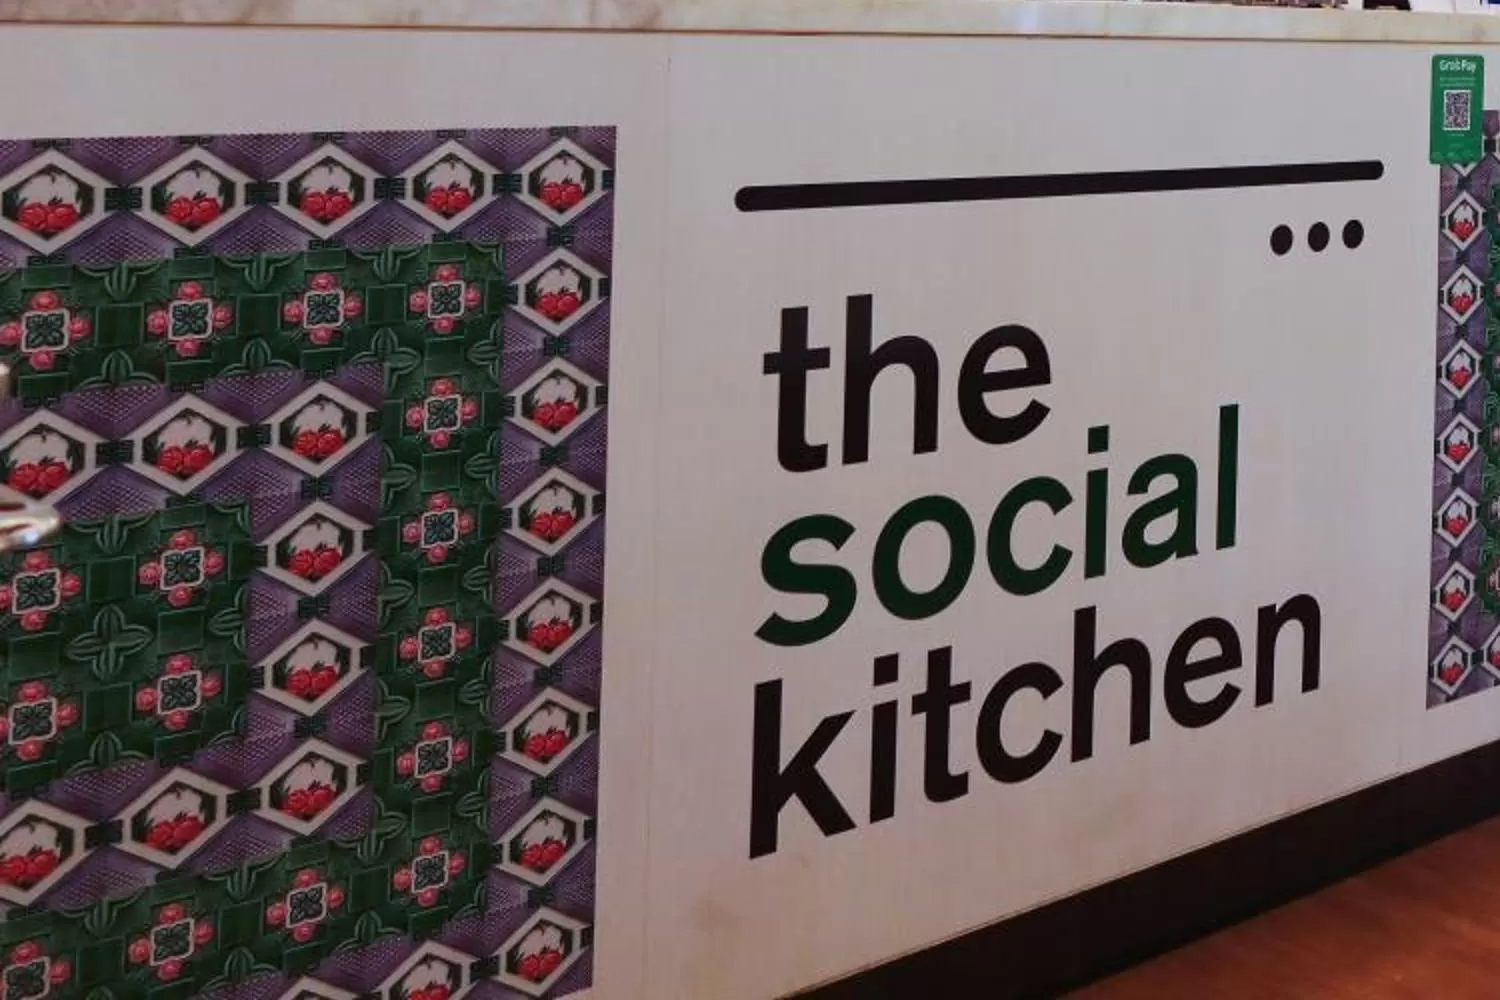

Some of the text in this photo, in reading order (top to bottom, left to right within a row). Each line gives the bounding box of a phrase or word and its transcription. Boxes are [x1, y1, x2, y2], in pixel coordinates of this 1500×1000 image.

[1439, 60, 1476, 73] GrabPay
[763, 294, 1051, 472] the
[755, 404, 1239, 647] social
[749, 593, 1321, 860] kitchen
